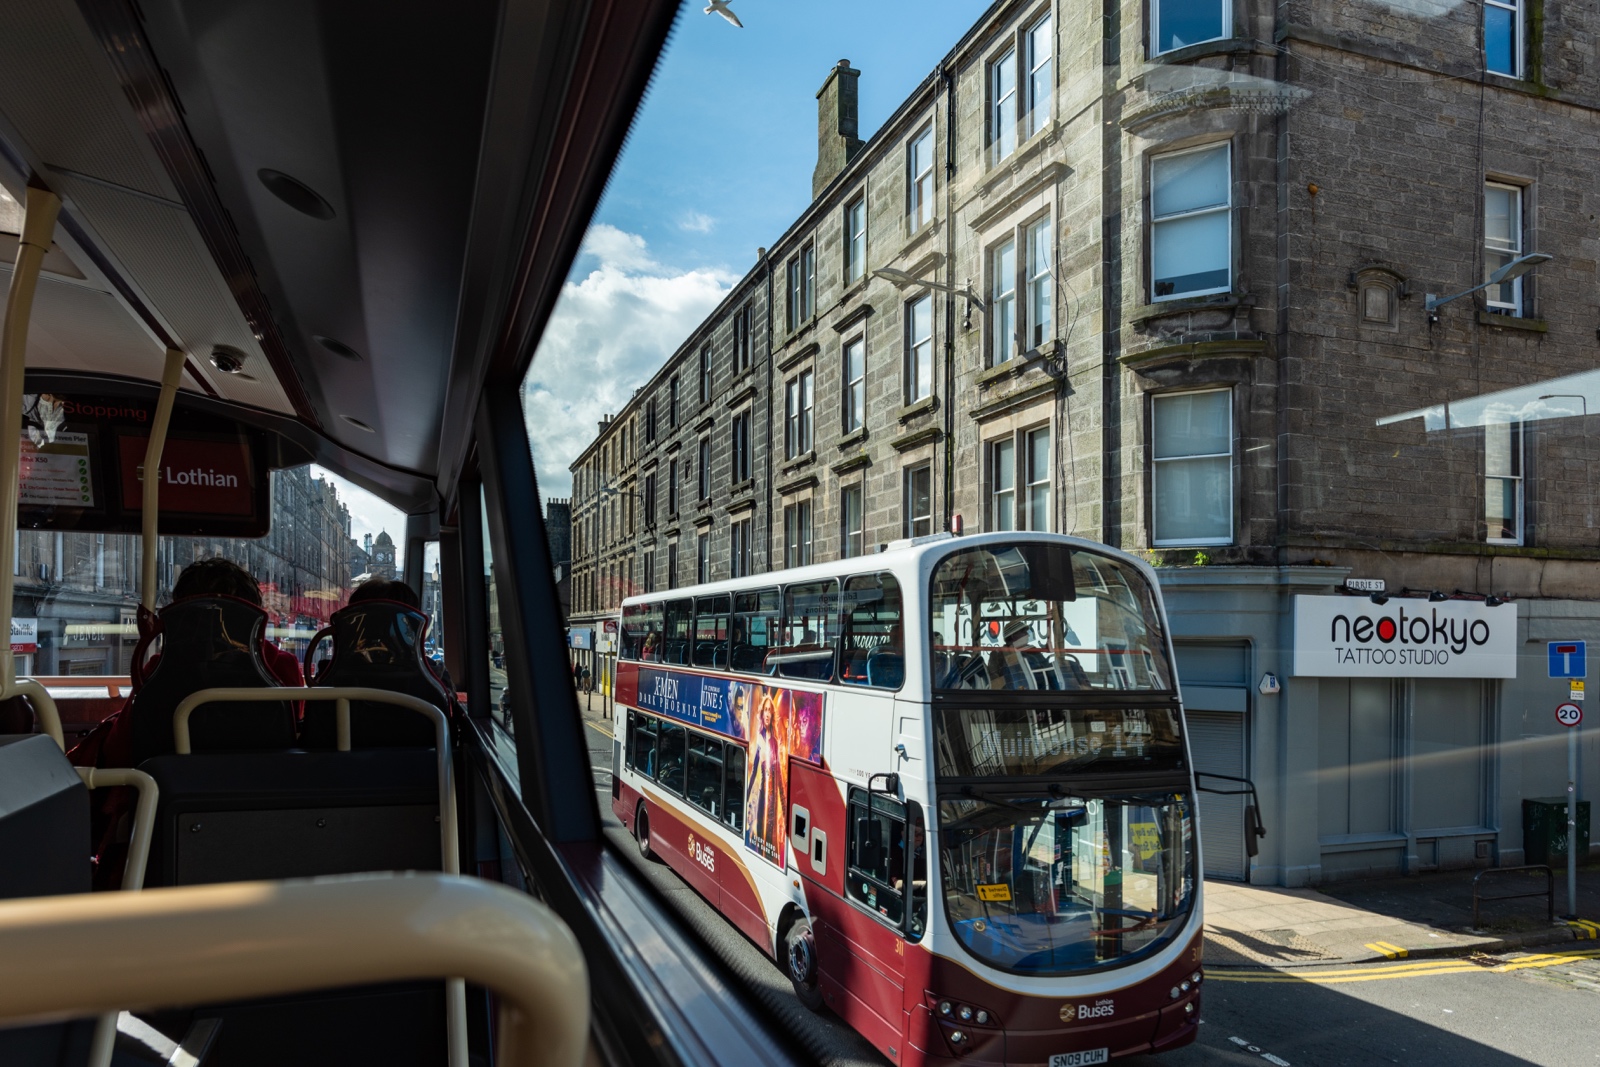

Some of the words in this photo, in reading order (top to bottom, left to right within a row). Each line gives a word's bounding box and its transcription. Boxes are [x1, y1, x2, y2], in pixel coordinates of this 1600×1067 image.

[62, 400, 147, 421] Stopping
[166, 466, 238, 488] Lothian
[1348, 580, 1372, 589] PIRRIE
[1374, 581, 1384, 589] ST
[1331, 606, 1490, 655] neotokyo
[1335, 647, 1397, 664] TATTOO
[1399, 648, 1449, 665] STUDIO
[638, 691, 656, 706] DARK
[659, 696, 697, 718] PHOENIX
[718, 694, 724, 710] 5
[1559, 709, 1579, 720] 20
[981, 730, 1102, 758] Muirhouse
[1111, 724, 1145, 757] 14
[695, 841, 715, 873] Buses
[1078, 1004, 1115, 1019] Buses
[1053, 1053, 1081, 1067] SN09
[1083, 1049, 1104, 1063] CUH
